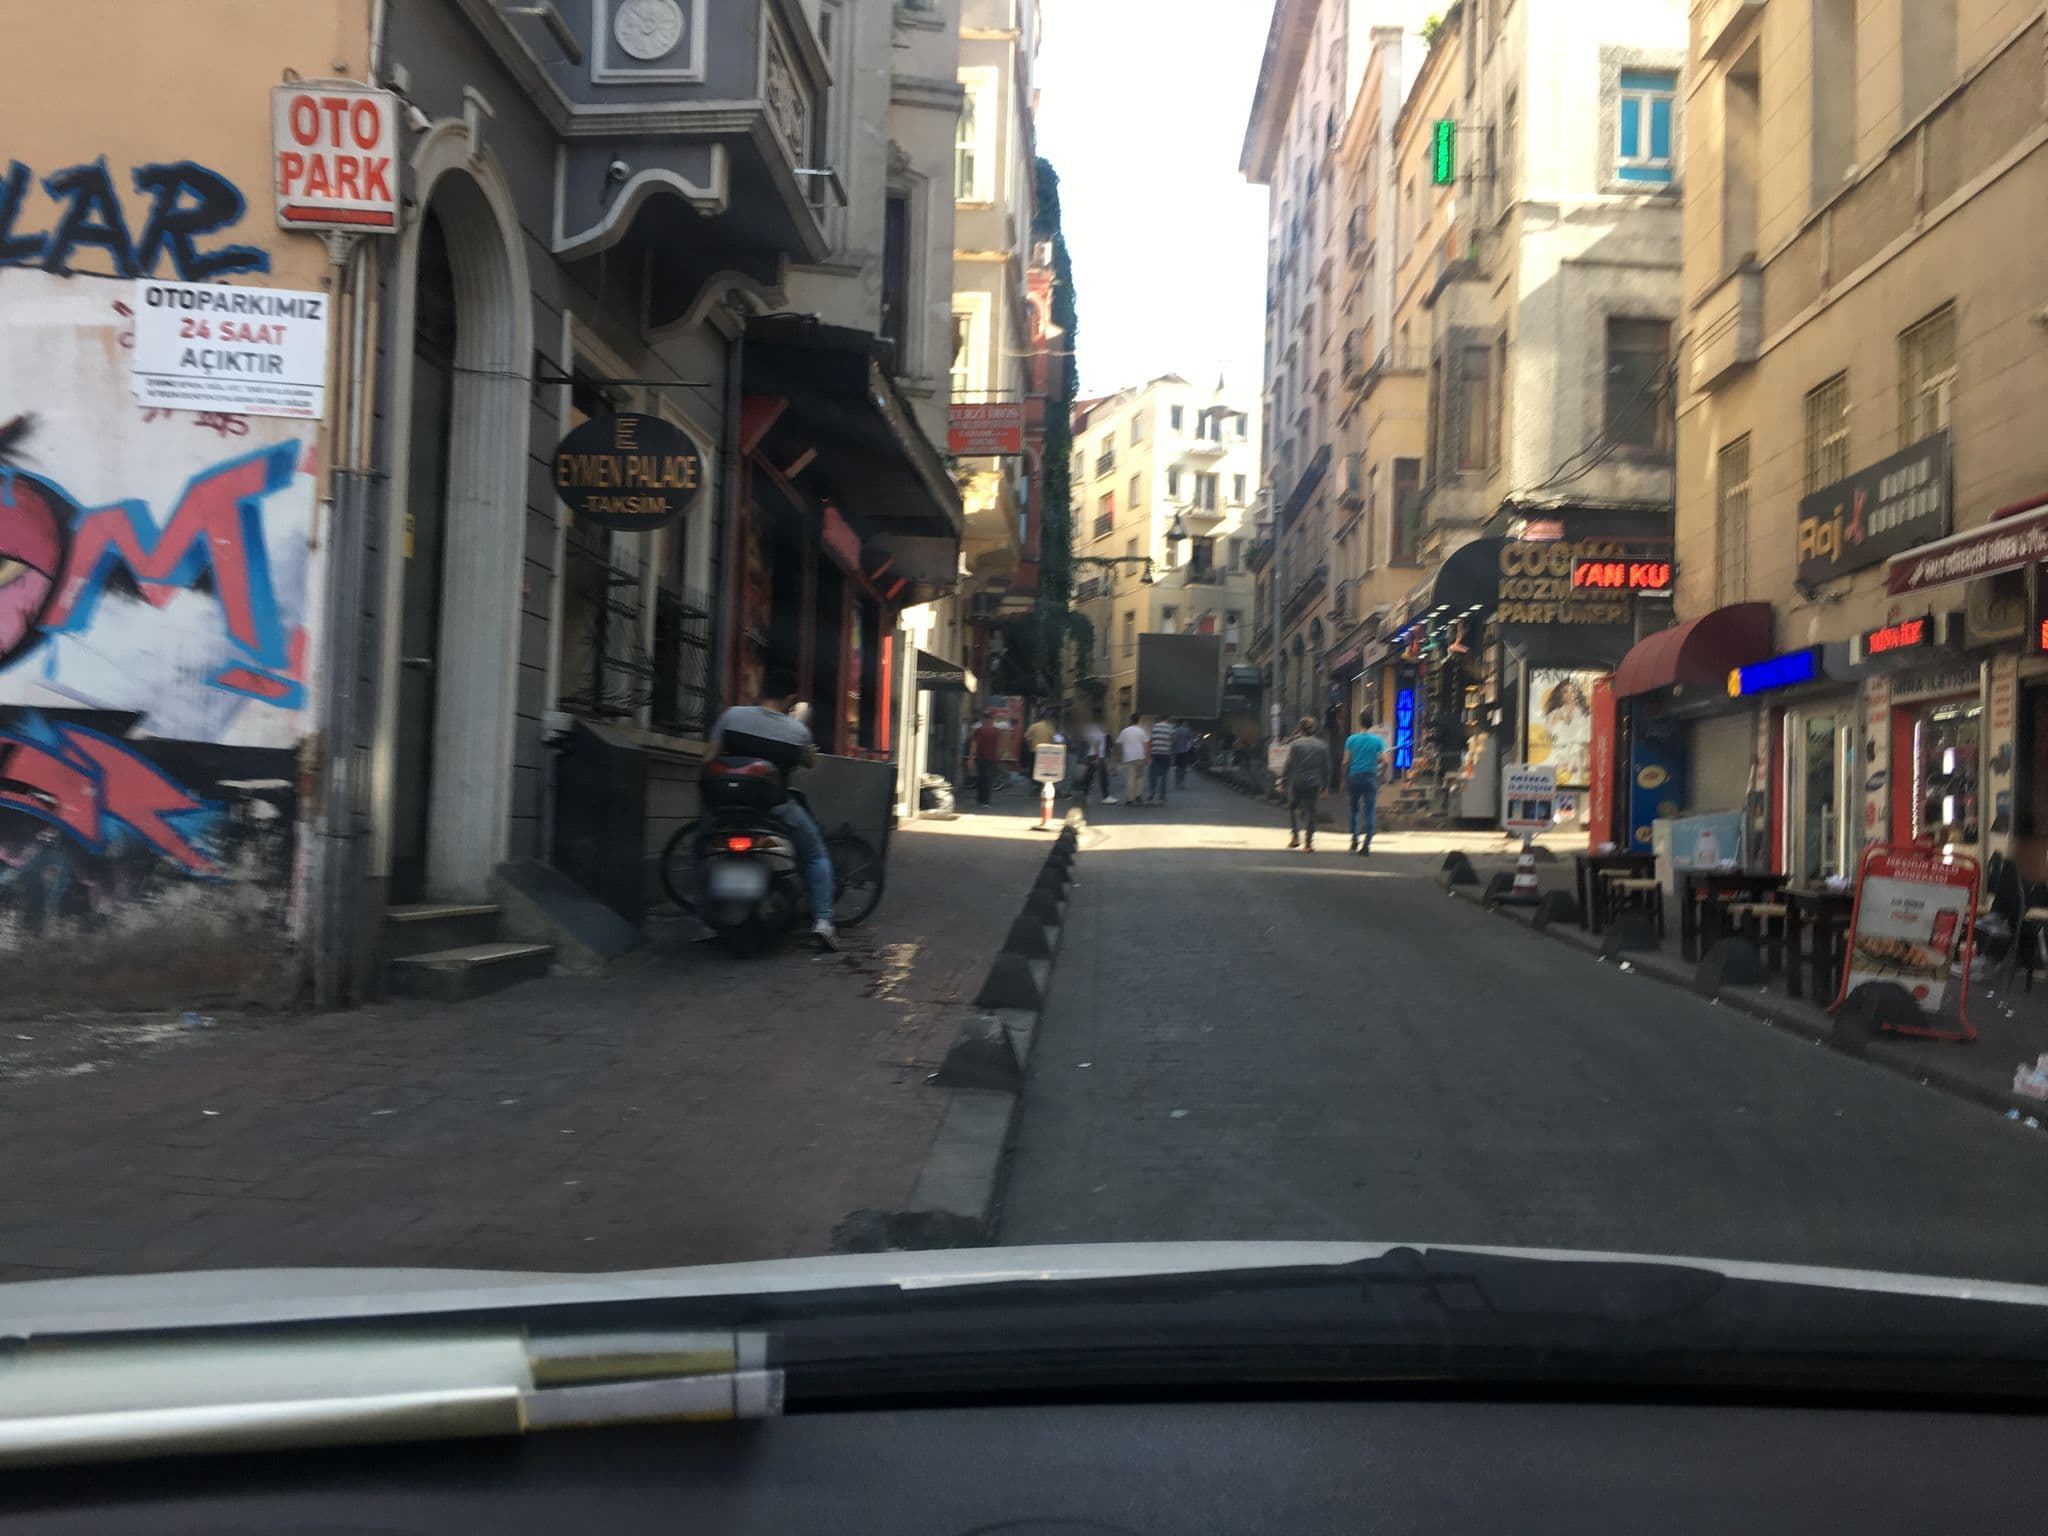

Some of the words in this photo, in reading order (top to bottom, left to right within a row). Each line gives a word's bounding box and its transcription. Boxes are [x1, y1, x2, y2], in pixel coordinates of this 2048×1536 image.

[288, 95, 381, 150] OTO
[279, 151, 393, 202] PARK
[145, 286, 322, 320] OTOPARKIMIZ
[179, 317, 211, 340] 24
[218, 320, 288, 345] SAAT
[180, 348, 284, 375] AÇIKTIR
[625, 455, 698, 489] PALACE
